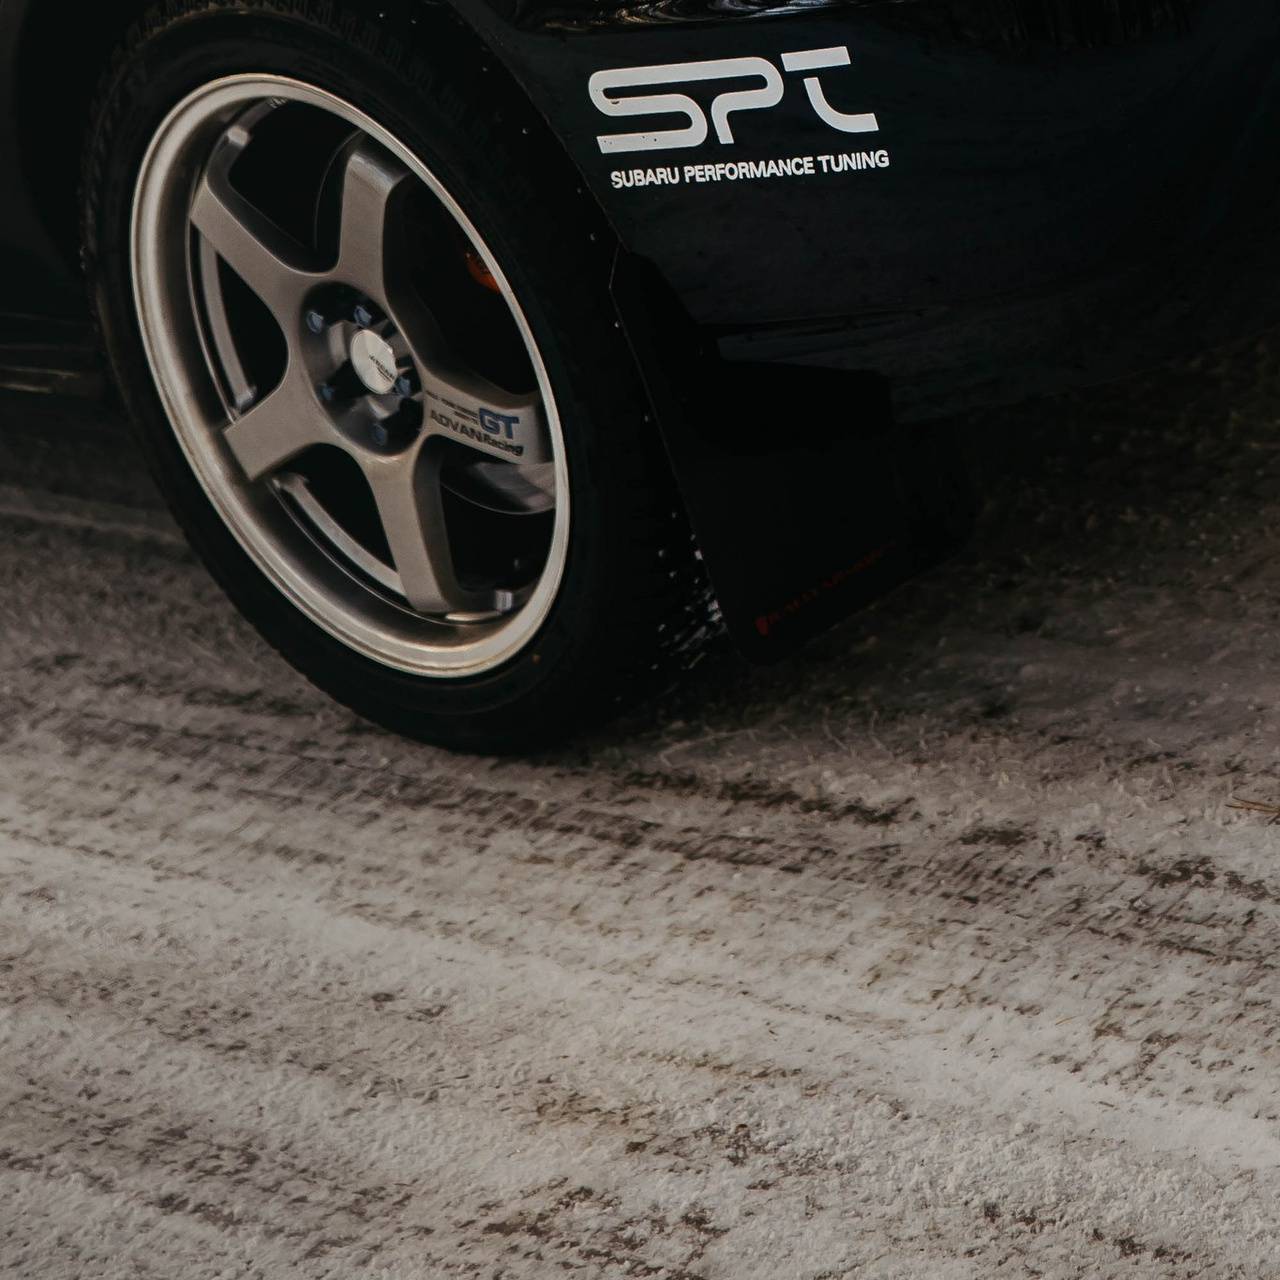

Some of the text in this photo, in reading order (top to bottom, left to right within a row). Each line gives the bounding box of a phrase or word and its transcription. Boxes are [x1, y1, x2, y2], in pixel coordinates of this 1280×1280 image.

[588, 46, 879, 154] SPT
[610, 148, 890, 190] SUBARU PERFORMANCE TUNING
[430, 409, 482, 443] ADVAN
[479, 406, 520, 440] GT
